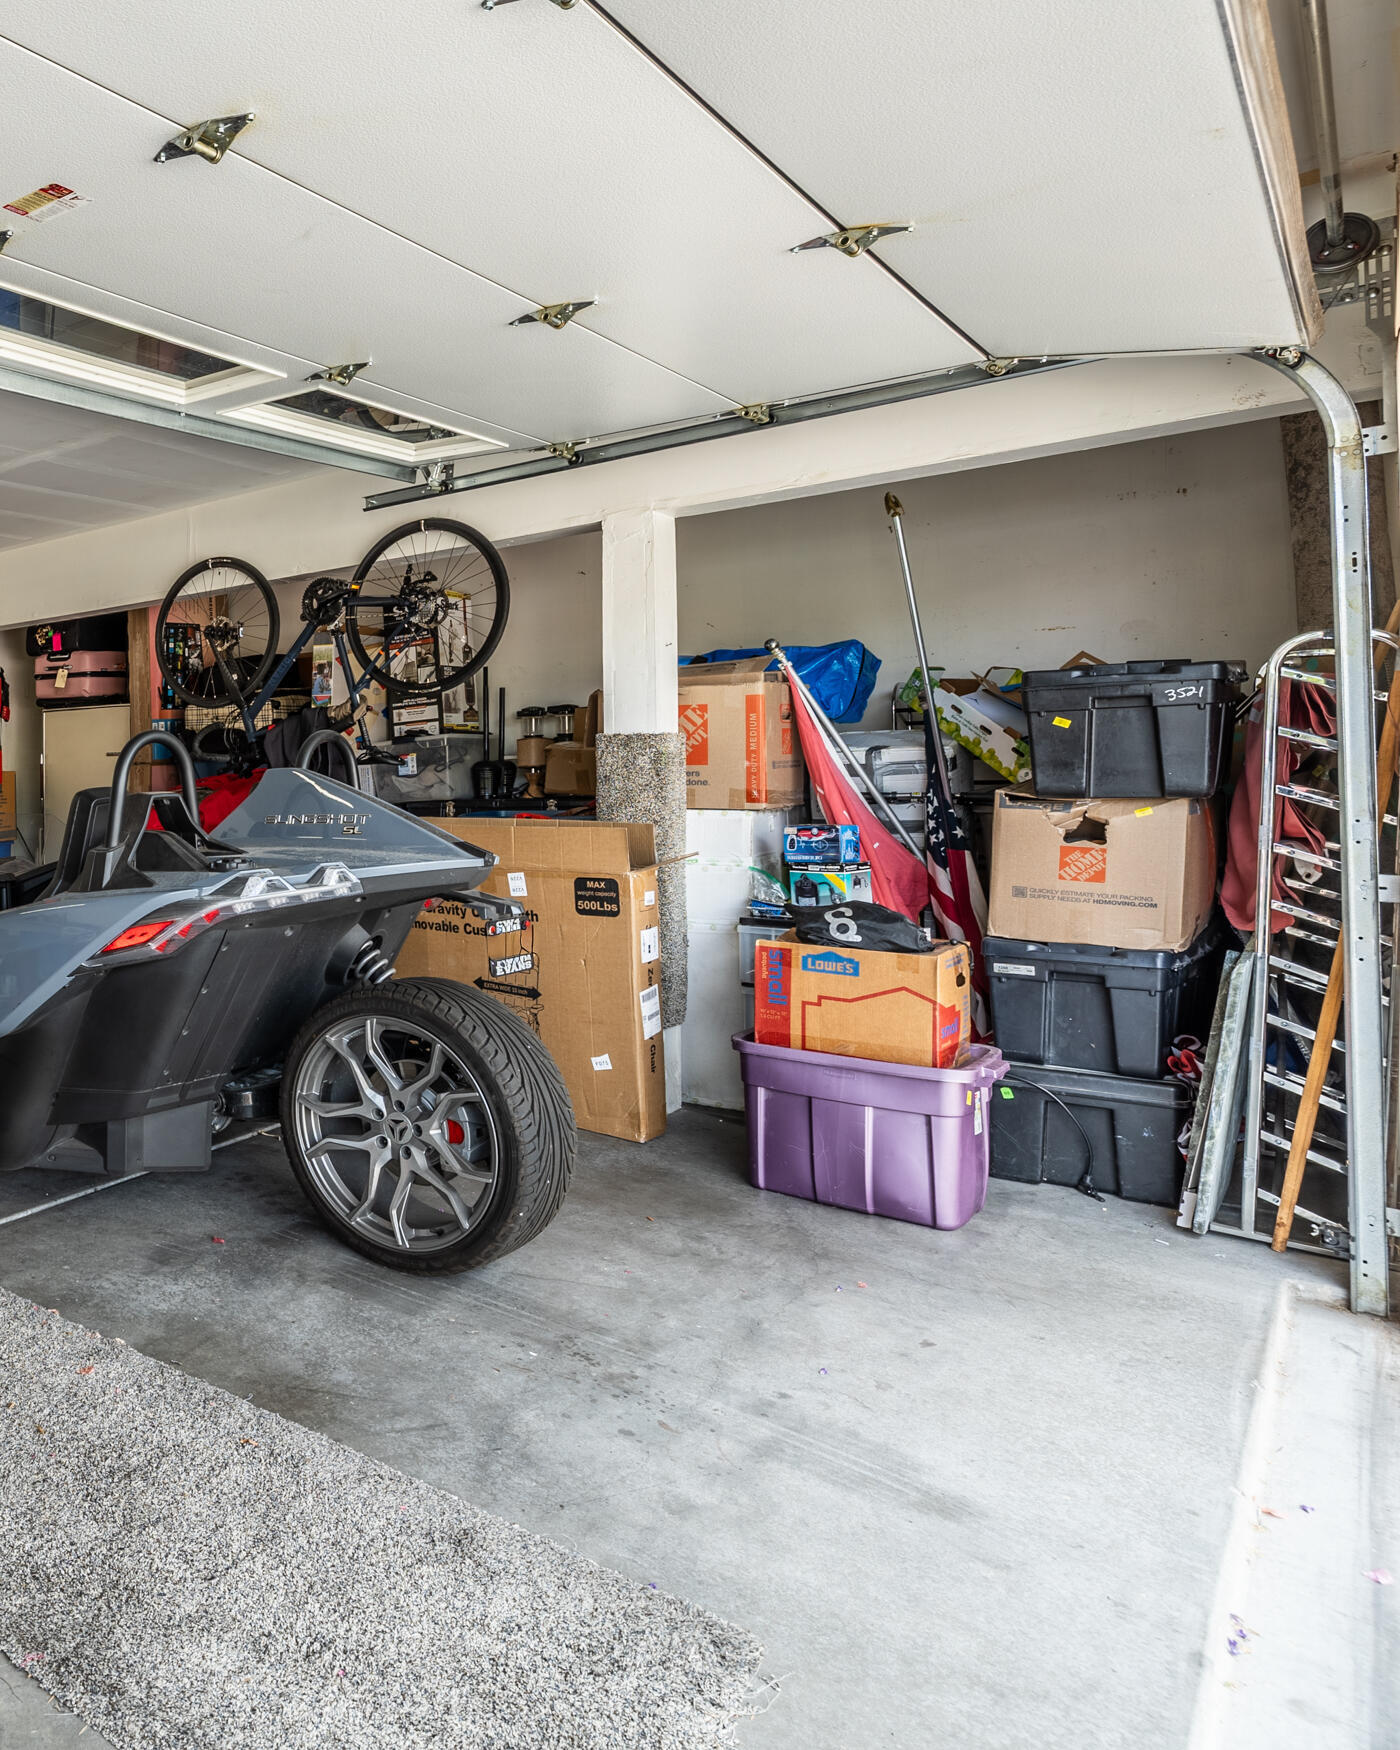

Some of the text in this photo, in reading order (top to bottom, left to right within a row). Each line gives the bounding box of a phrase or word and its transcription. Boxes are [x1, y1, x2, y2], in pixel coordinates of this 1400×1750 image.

[1165, 686, 1204, 701] 3521
[749, 713, 758, 750] MEDIUM
[264, 813, 369, 825] SLINGSHOT
[342, 826, 362, 834] SL
[1059, 847, 1106, 880] HOME
[1064, 850, 1082, 864] THE
[1077, 862, 1105, 882] DEPOT
[586, 881, 606, 889] MAX
[1029, 887, 1059, 895] QUICKLY
[1060, 889, 1096, 898] ESTIMATE
[1119, 894, 1153, 902] PACKING
[1059, 895, 1081, 903] NEEDS
[1092, 899, 1158, 908] HDMOVING.COM
[577, 900, 618, 912] 500Lbs
[807, 957, 854, 973] LOWE'S
[768, 949, 787, 1005] small
[942, 1017, 959, 1039] small
